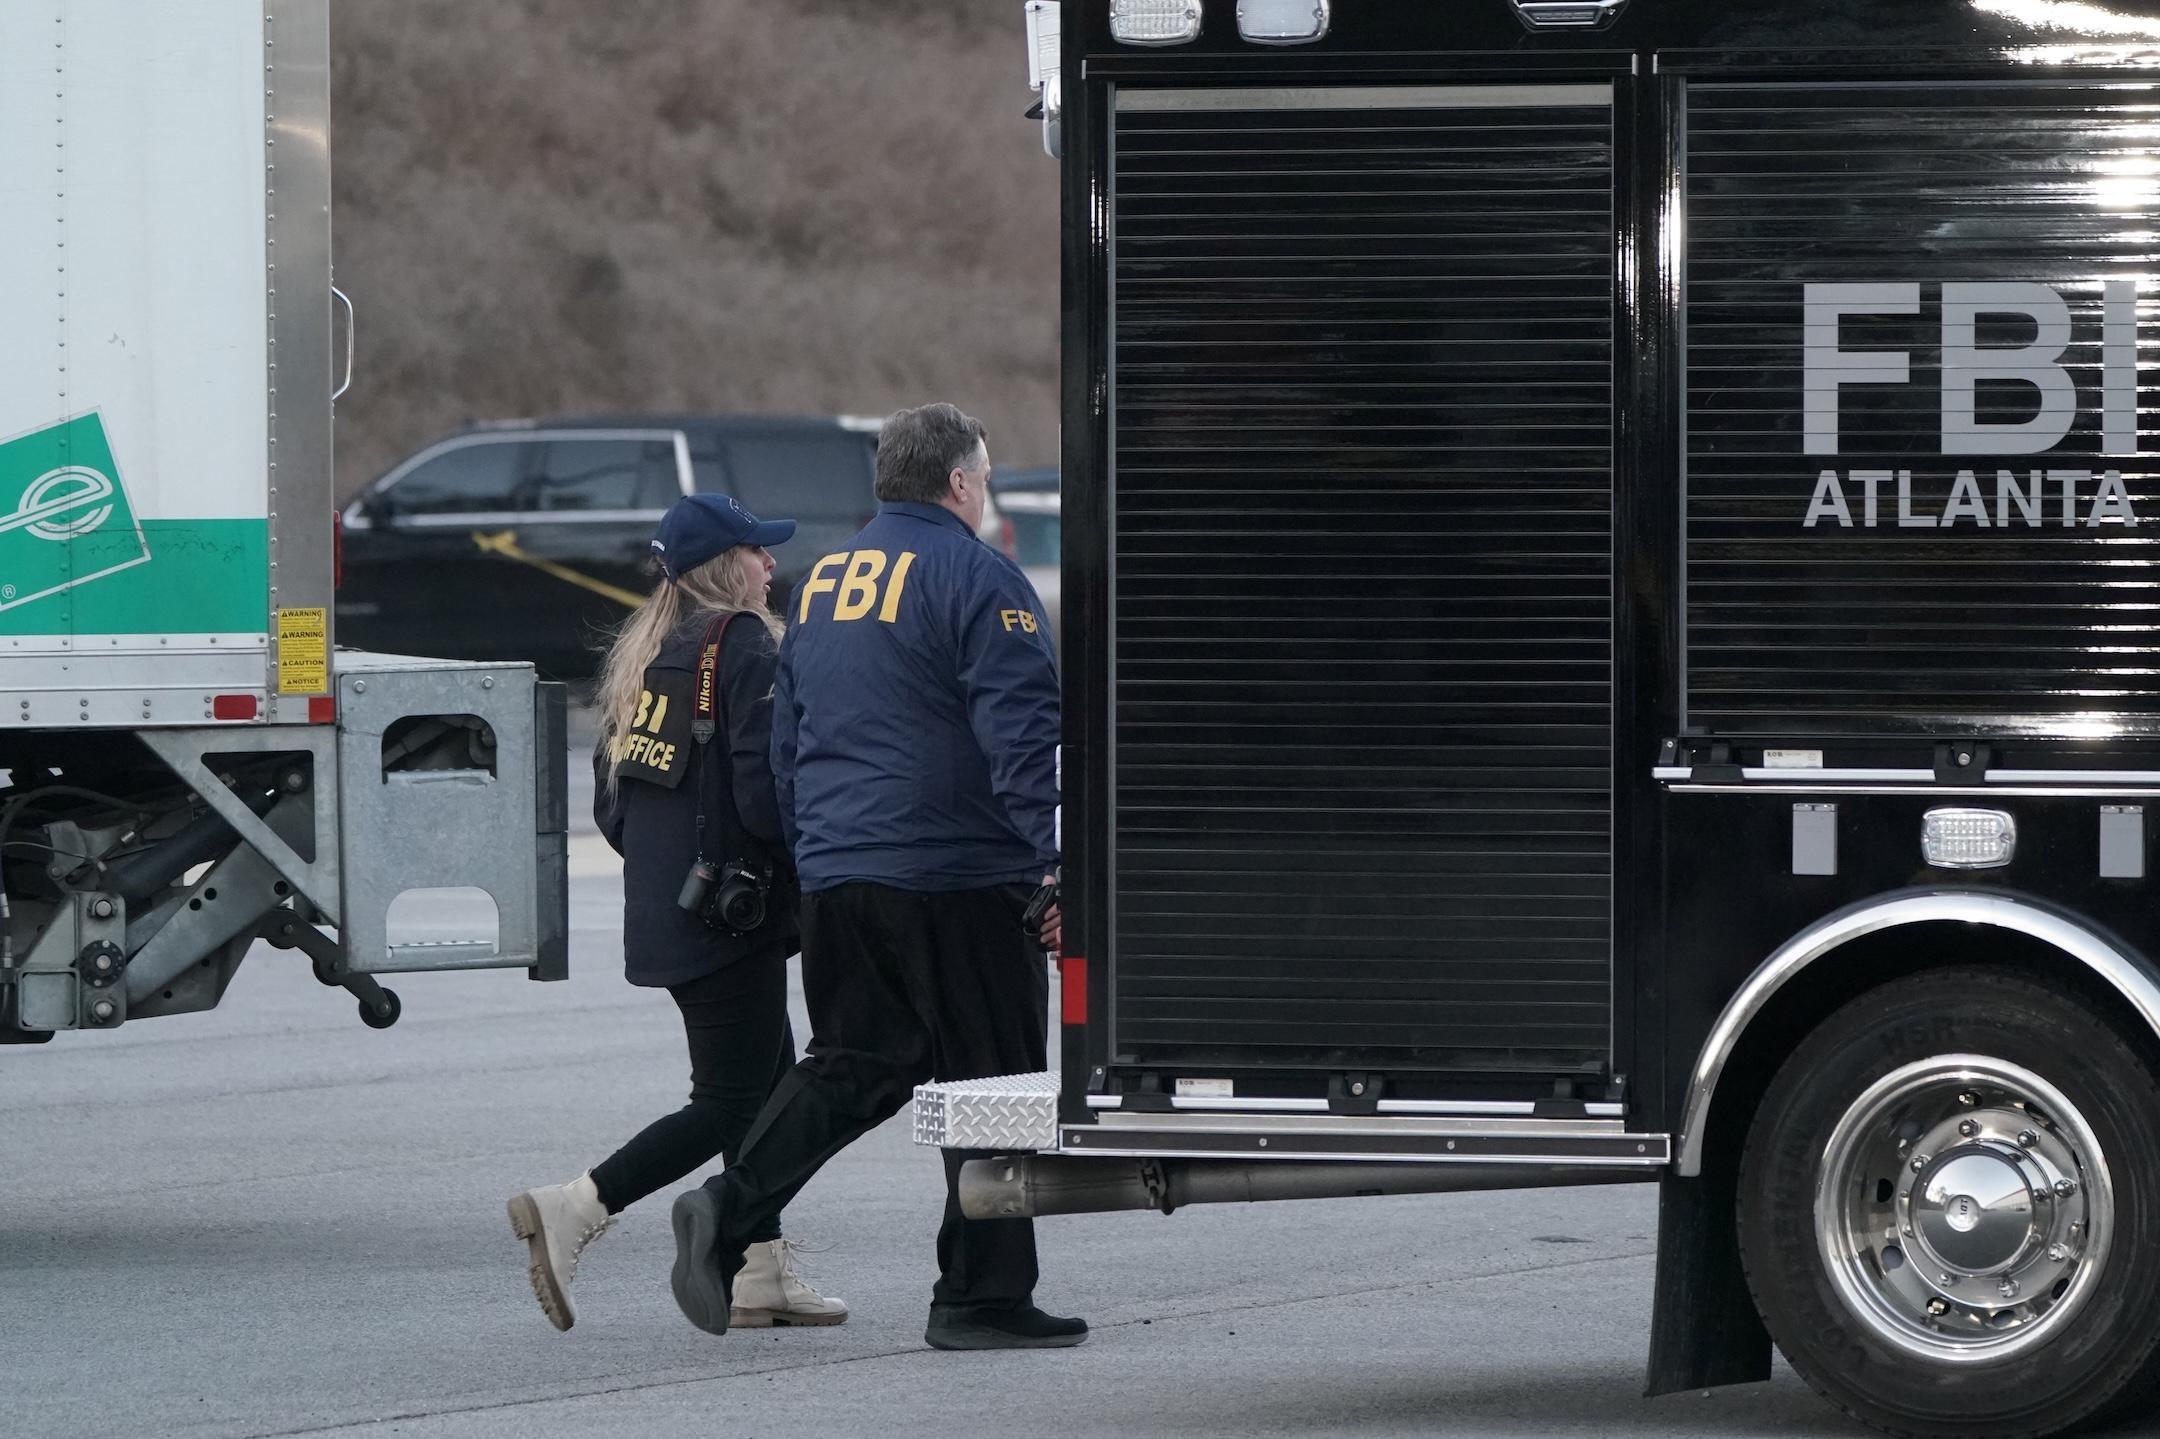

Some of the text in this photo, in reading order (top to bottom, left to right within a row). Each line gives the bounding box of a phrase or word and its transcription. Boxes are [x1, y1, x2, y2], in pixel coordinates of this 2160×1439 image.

[1803, 282, 2138, 455] FBI
[1802, 470, 2138, 527] ATLANTA
[799, 549, 917, 624] FBI
[632, 690, 669, 734] BI
[699, 670, 712, 712] Nikon
[624, 733, 675, 772] FFICE
